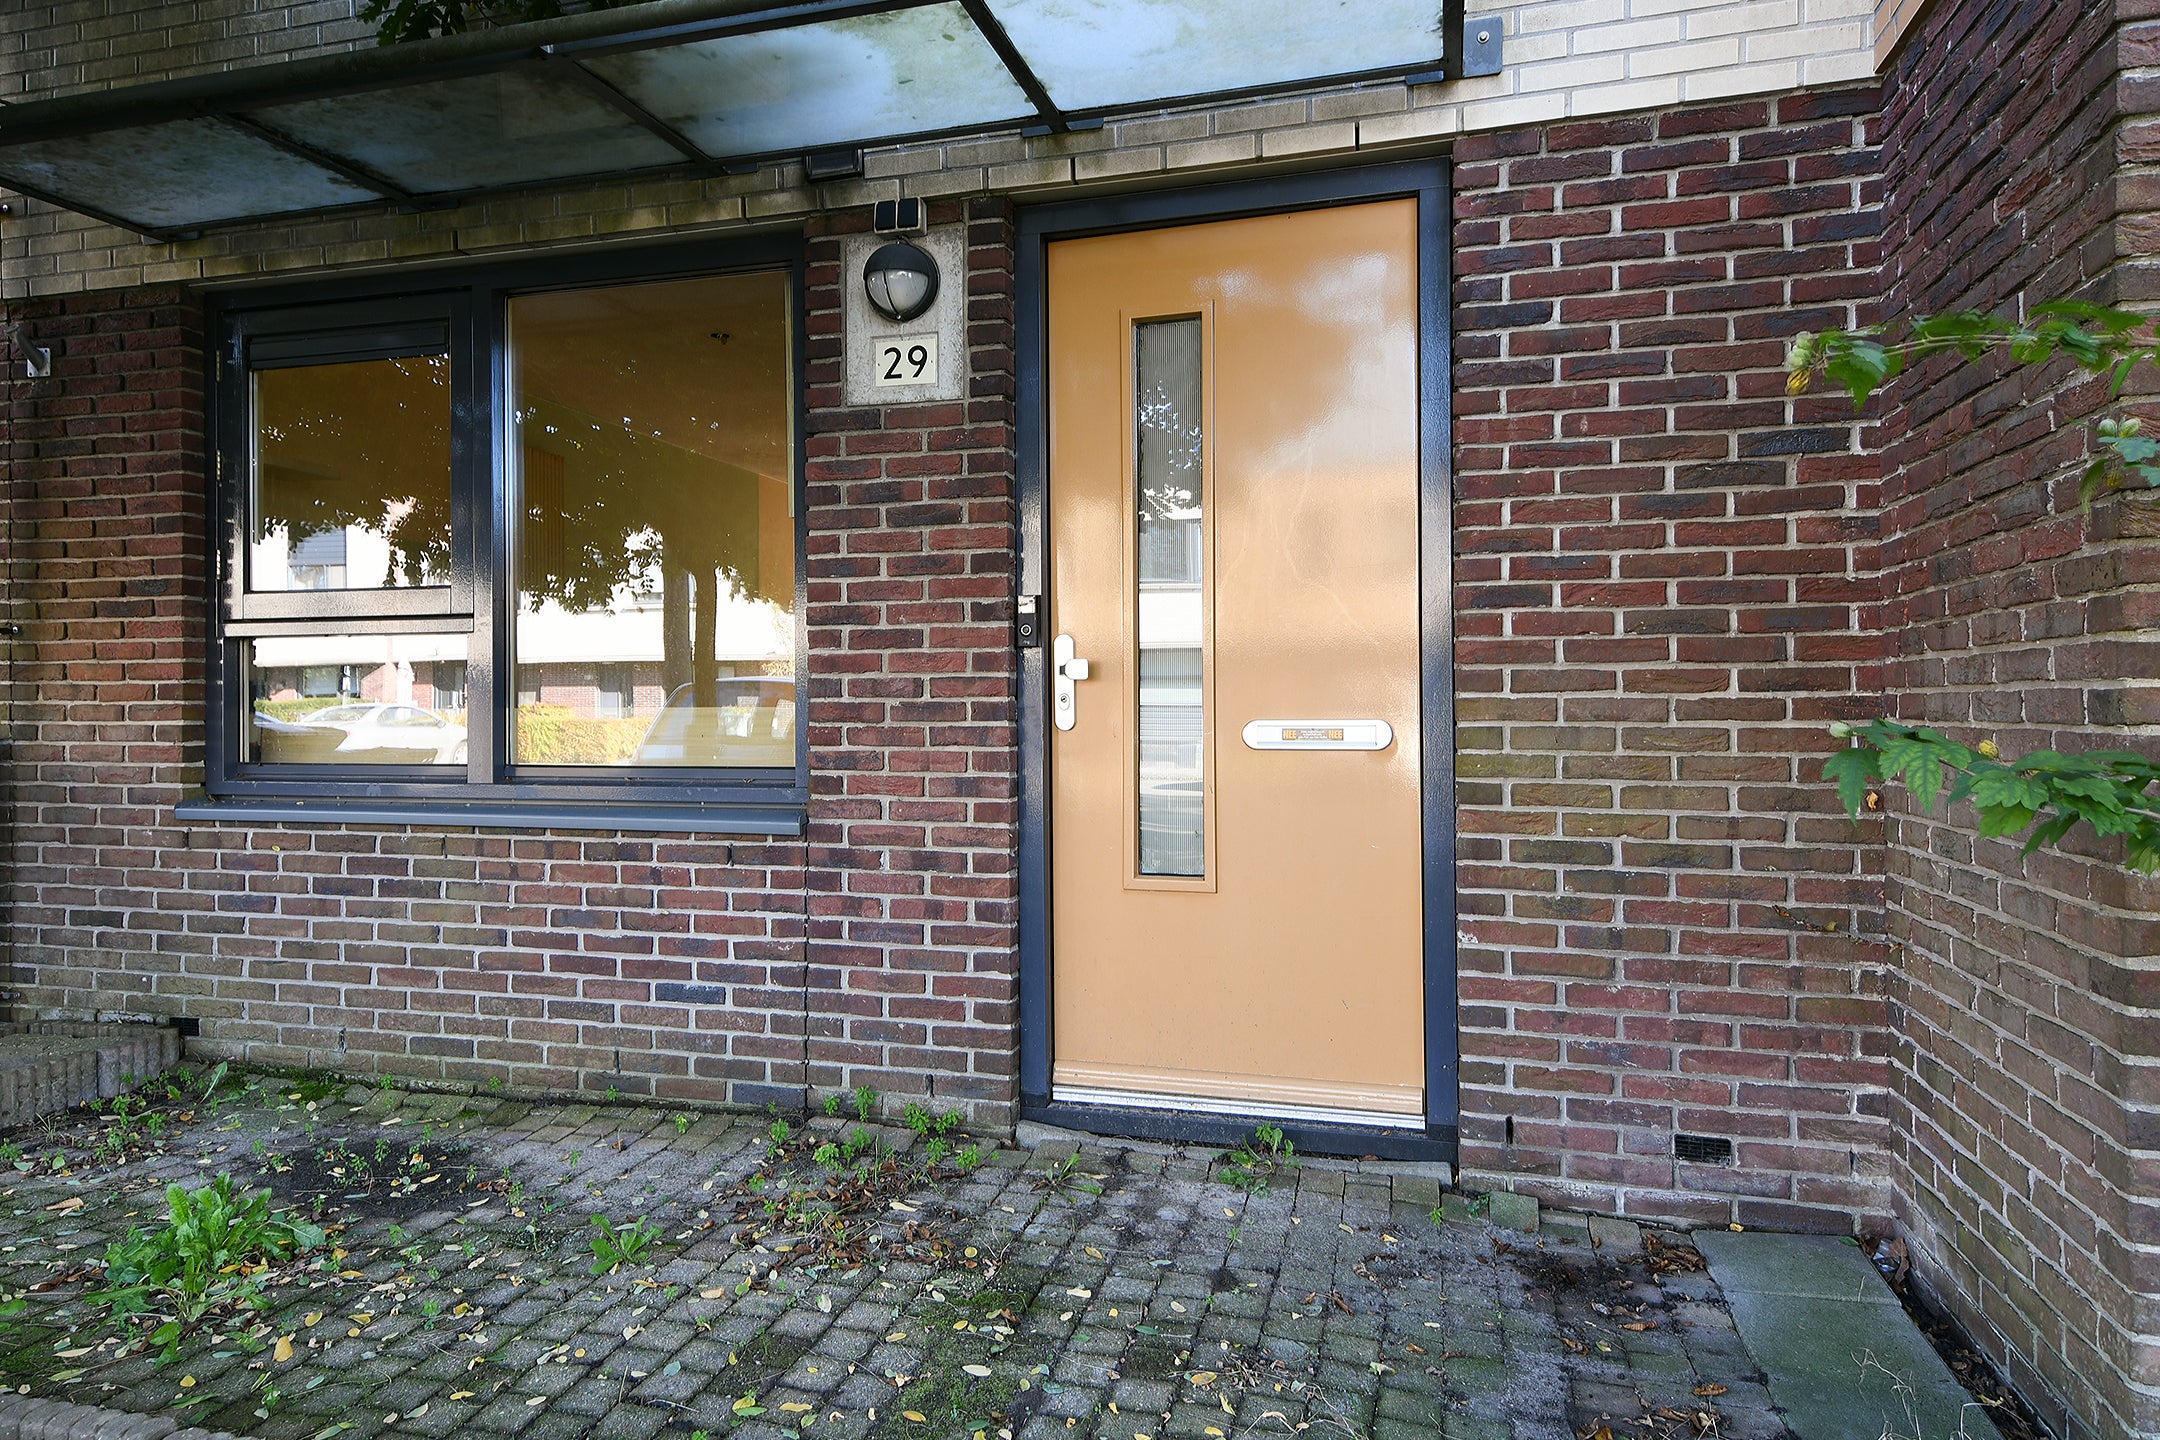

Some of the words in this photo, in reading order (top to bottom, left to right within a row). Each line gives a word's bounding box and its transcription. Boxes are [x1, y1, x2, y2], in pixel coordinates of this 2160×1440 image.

[884, 345, 928, 380] 29
[1284, 730, 1297, 740] NEE
[1329, 730, 1343, 740] NEE
